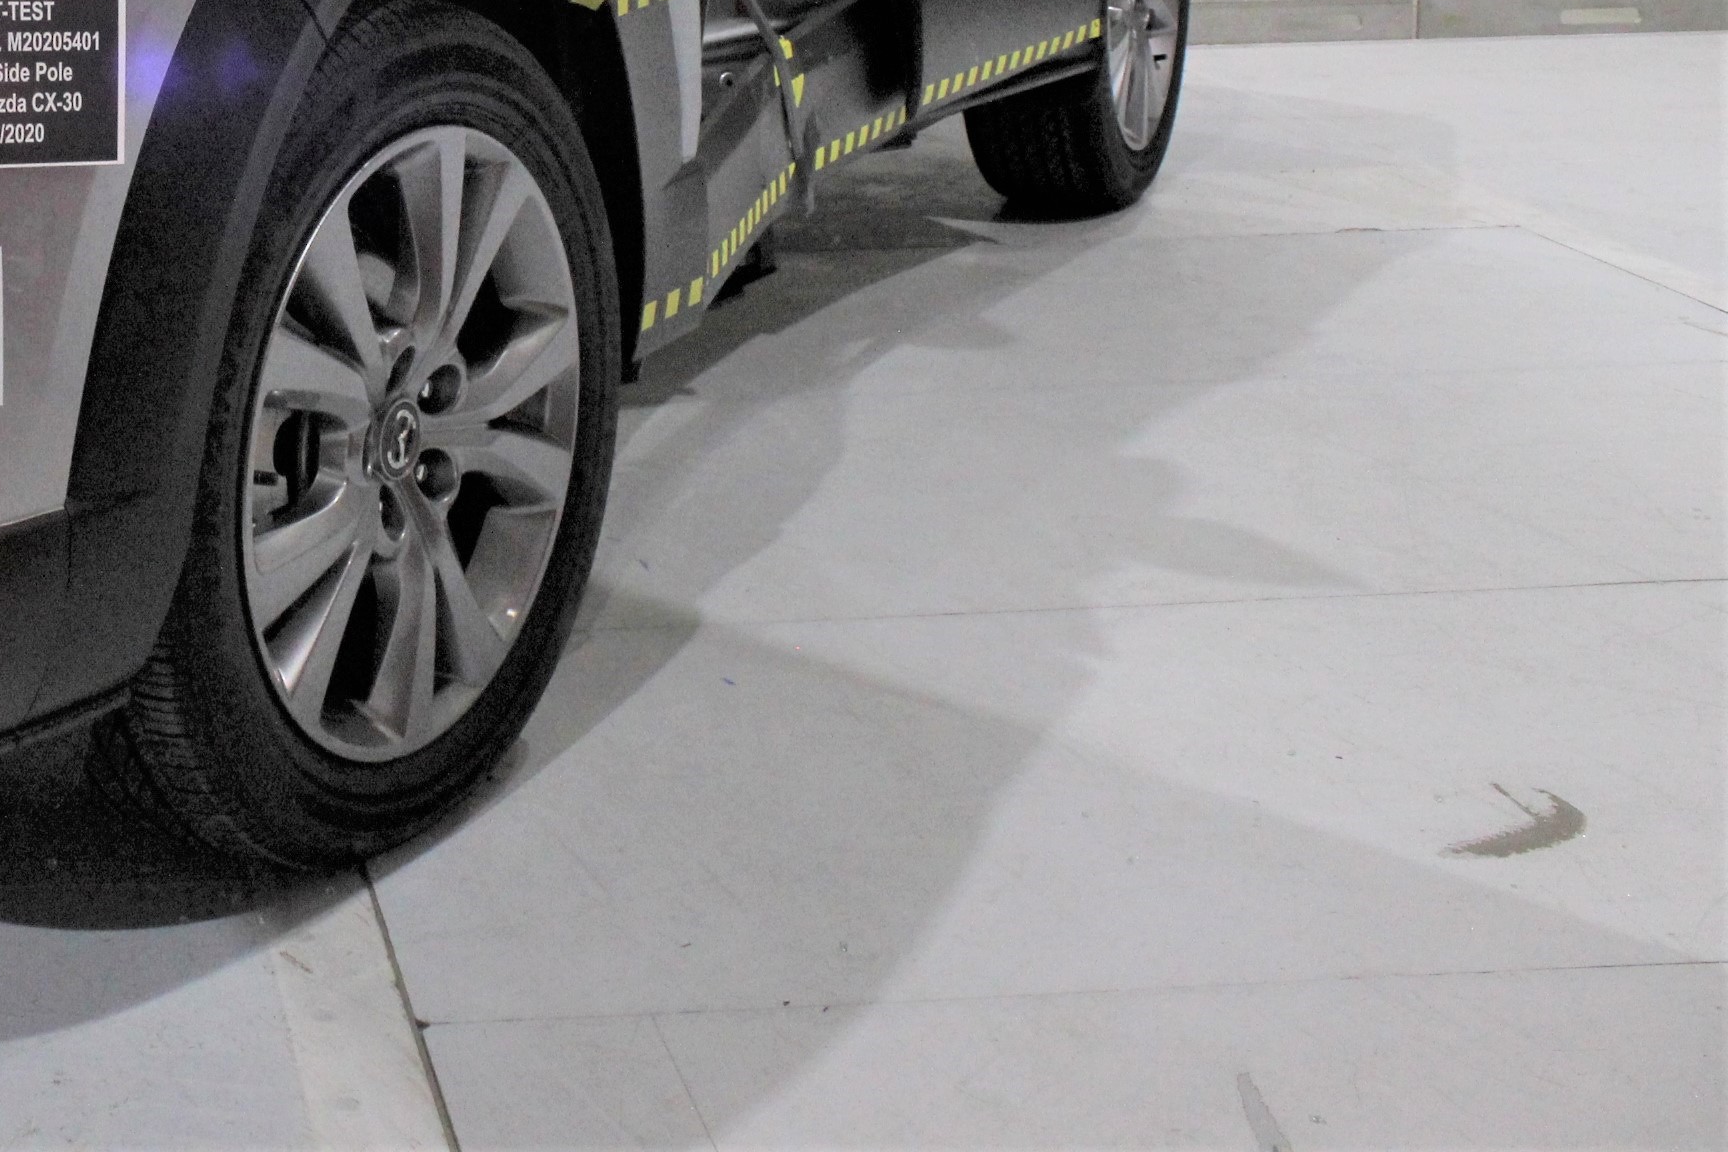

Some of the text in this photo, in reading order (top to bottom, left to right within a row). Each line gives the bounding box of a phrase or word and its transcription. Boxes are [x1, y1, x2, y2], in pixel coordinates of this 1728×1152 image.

[7, 31, 100, 52] M20205401
[35, 61, 73, 82] Pole
[31, 91, 83, 113] CX-30
